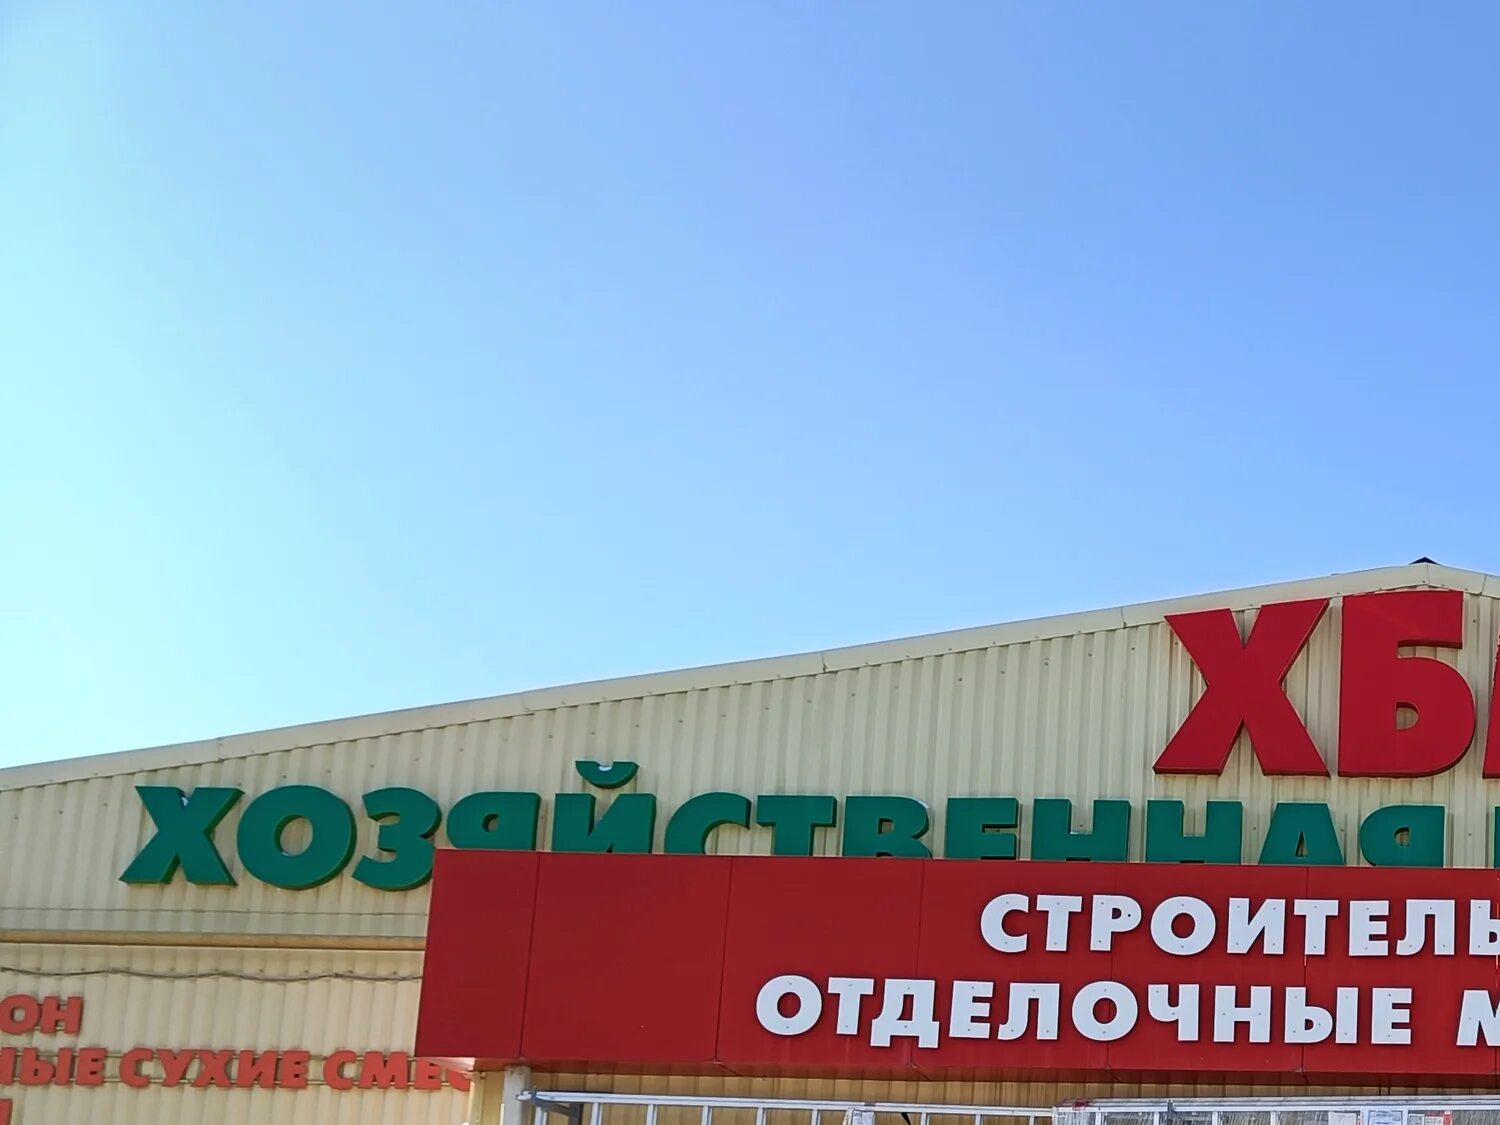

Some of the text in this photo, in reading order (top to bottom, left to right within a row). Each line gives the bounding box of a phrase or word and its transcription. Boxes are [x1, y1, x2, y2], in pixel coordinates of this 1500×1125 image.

[119, 760, 1446, 891] ХОЗЯЙСТВЕННАЯ
[756, 974, 1413, 1049] ОТДЕЛОЧНЫЕ
[119, 1048, 311, 1088] СУХИЕ
